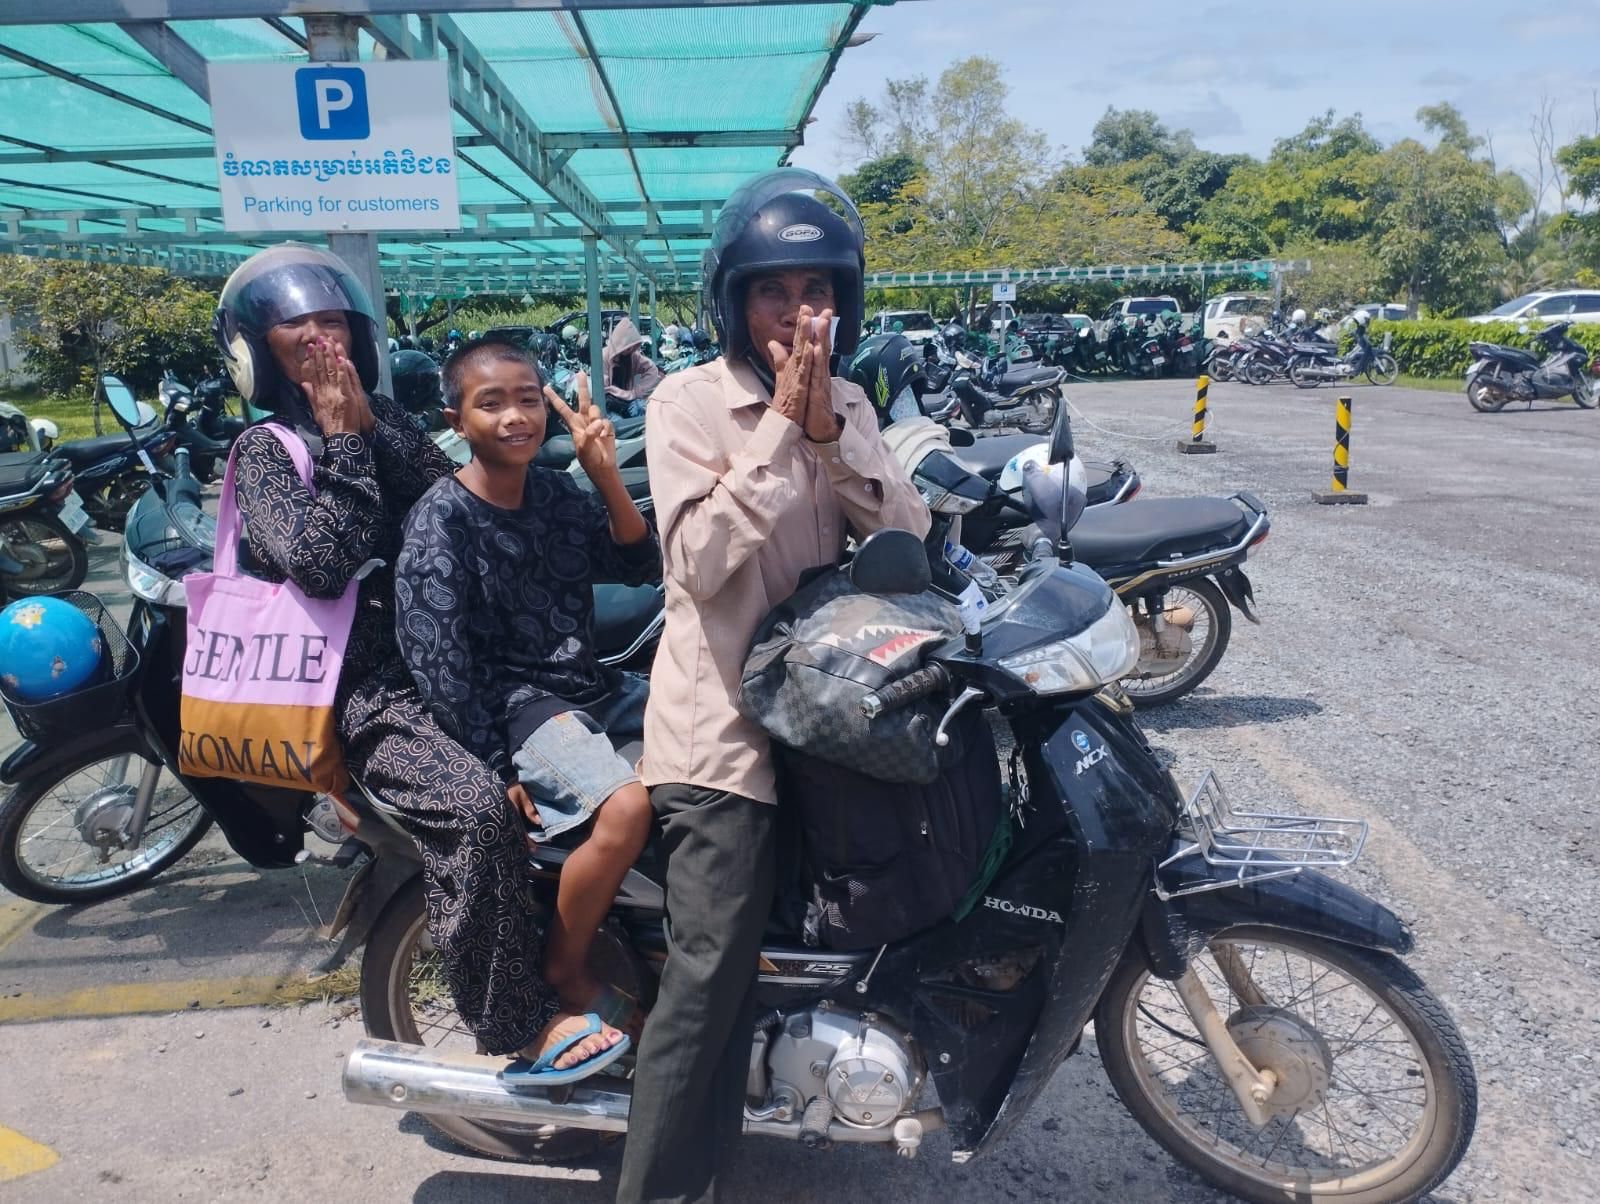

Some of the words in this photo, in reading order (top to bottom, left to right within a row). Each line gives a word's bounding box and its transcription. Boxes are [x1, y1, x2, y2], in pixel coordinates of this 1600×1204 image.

[315, 79, 353, 130] P
[244, 196, 313, 215] Parking
[318, 196, 342, 213] for
[347, 197, 440, 213] customers
[983, 896, 1064, 923] HONDA
[804, 962, 853, 976] 125
